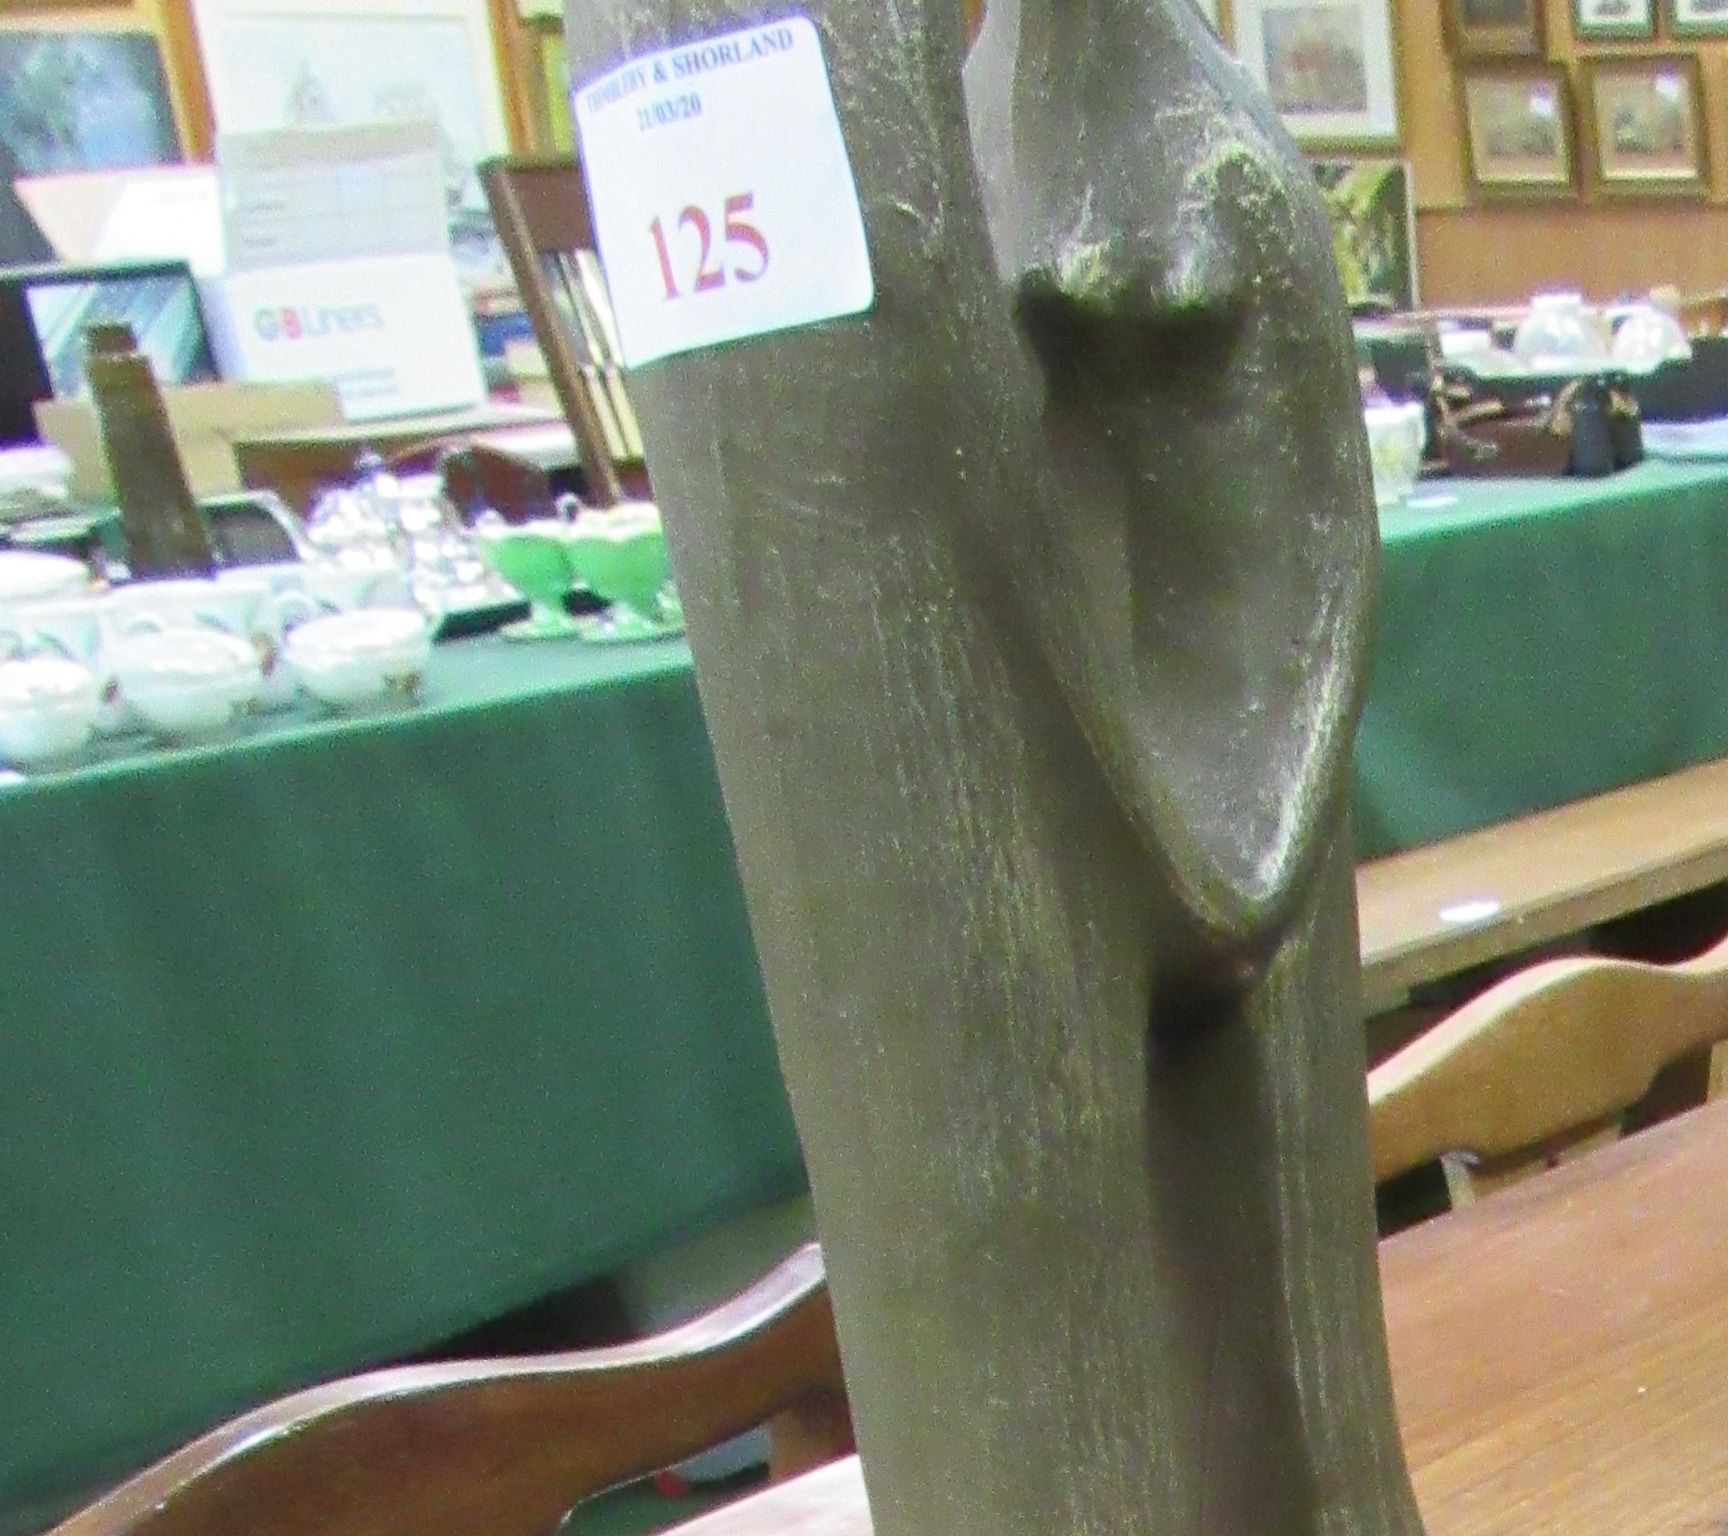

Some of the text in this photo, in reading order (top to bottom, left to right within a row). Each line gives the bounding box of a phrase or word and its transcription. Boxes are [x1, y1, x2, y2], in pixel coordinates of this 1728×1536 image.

[653, 61, 668, 83] &
[672, 26, 794, 79] SHORLAND
[649, 190, 770, 301] 125
